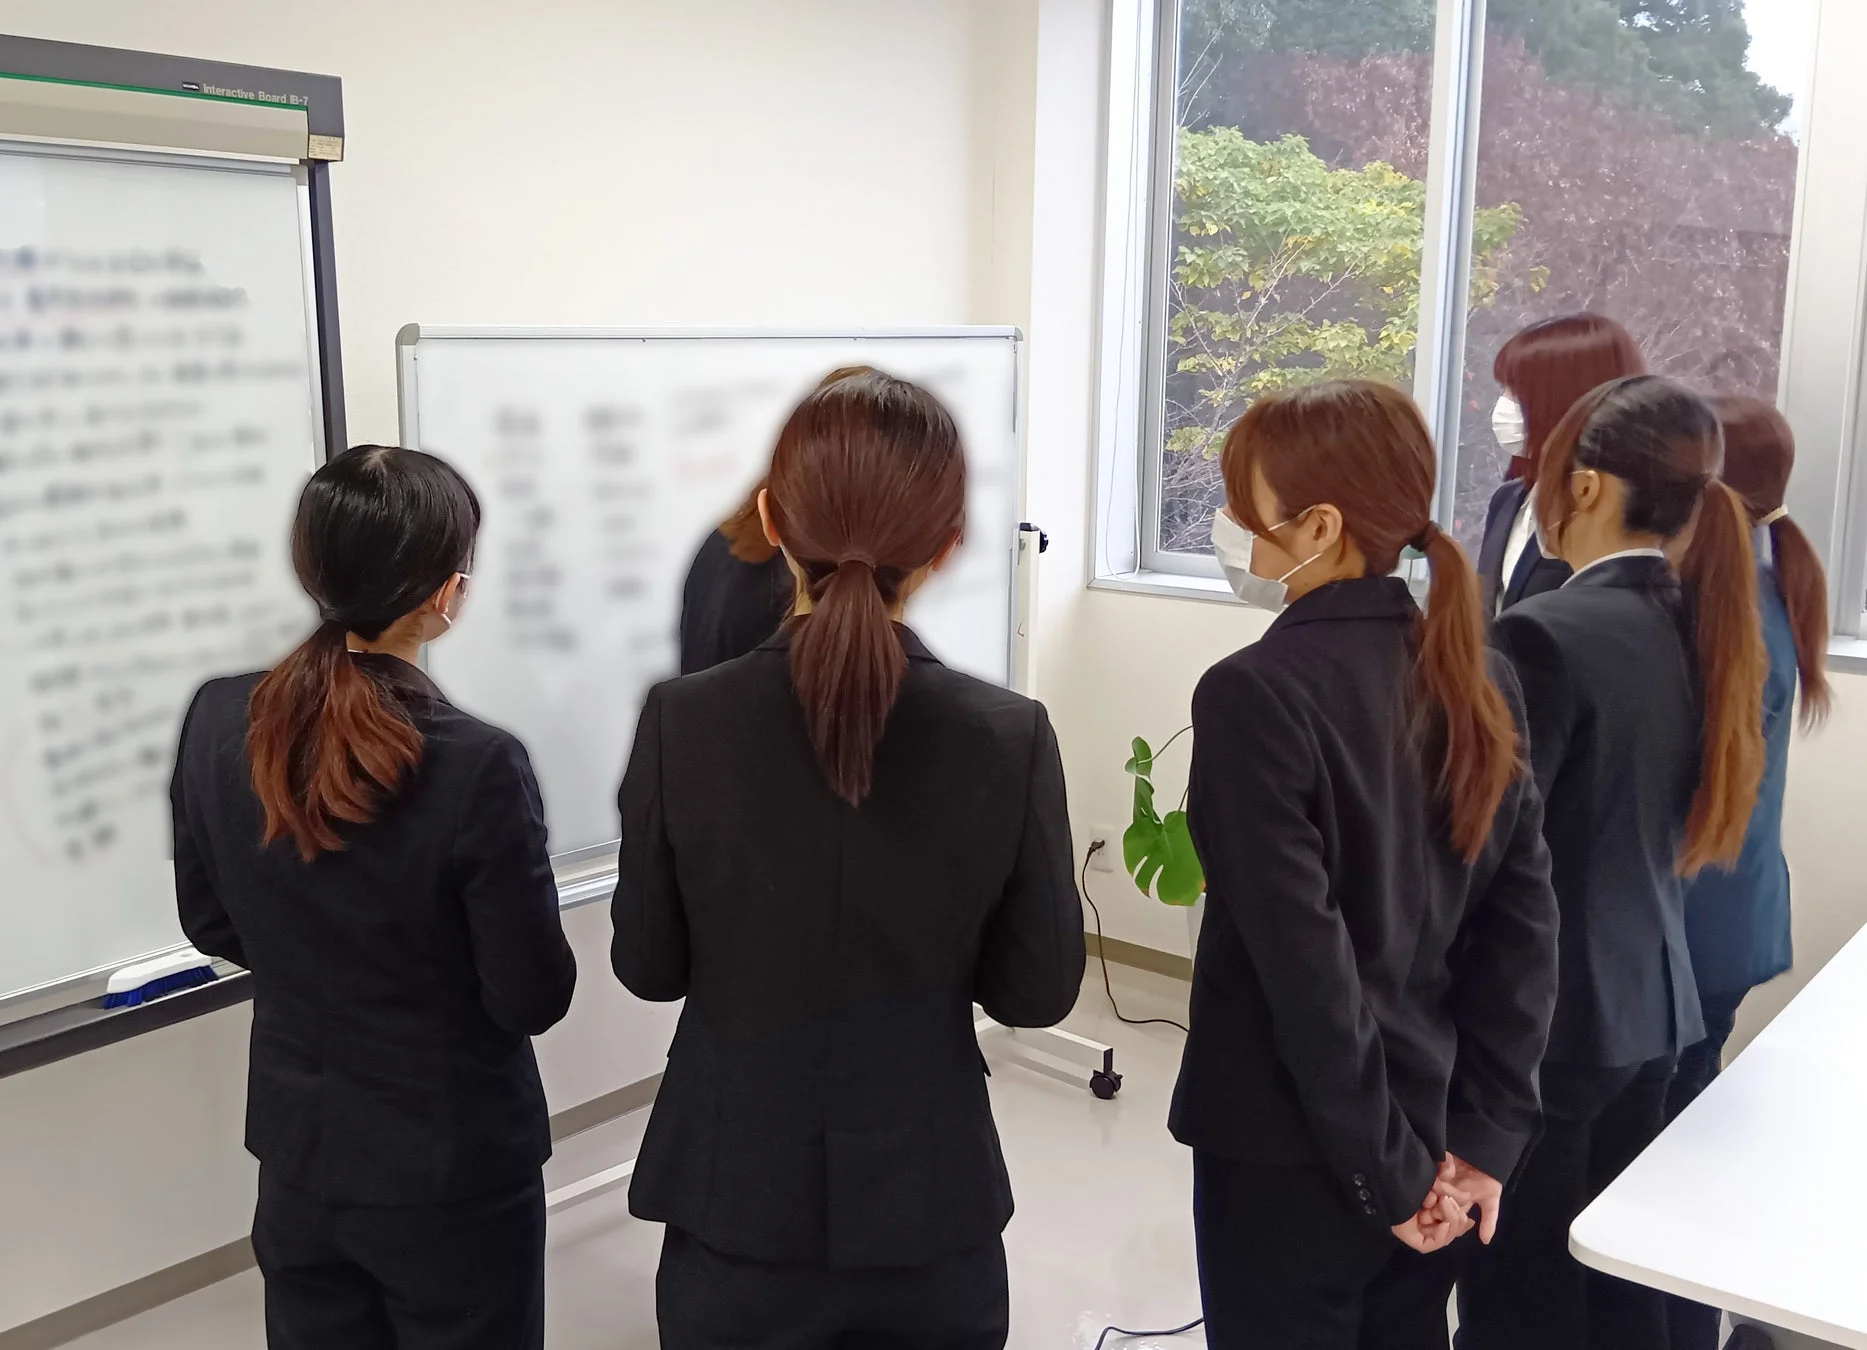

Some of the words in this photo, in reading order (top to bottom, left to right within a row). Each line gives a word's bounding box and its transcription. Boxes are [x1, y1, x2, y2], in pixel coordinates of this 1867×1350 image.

[203, 83, 255, 100] Interactive
[258, 91, 287, 104] Board
[290, 95, 309, 106] IB-7
